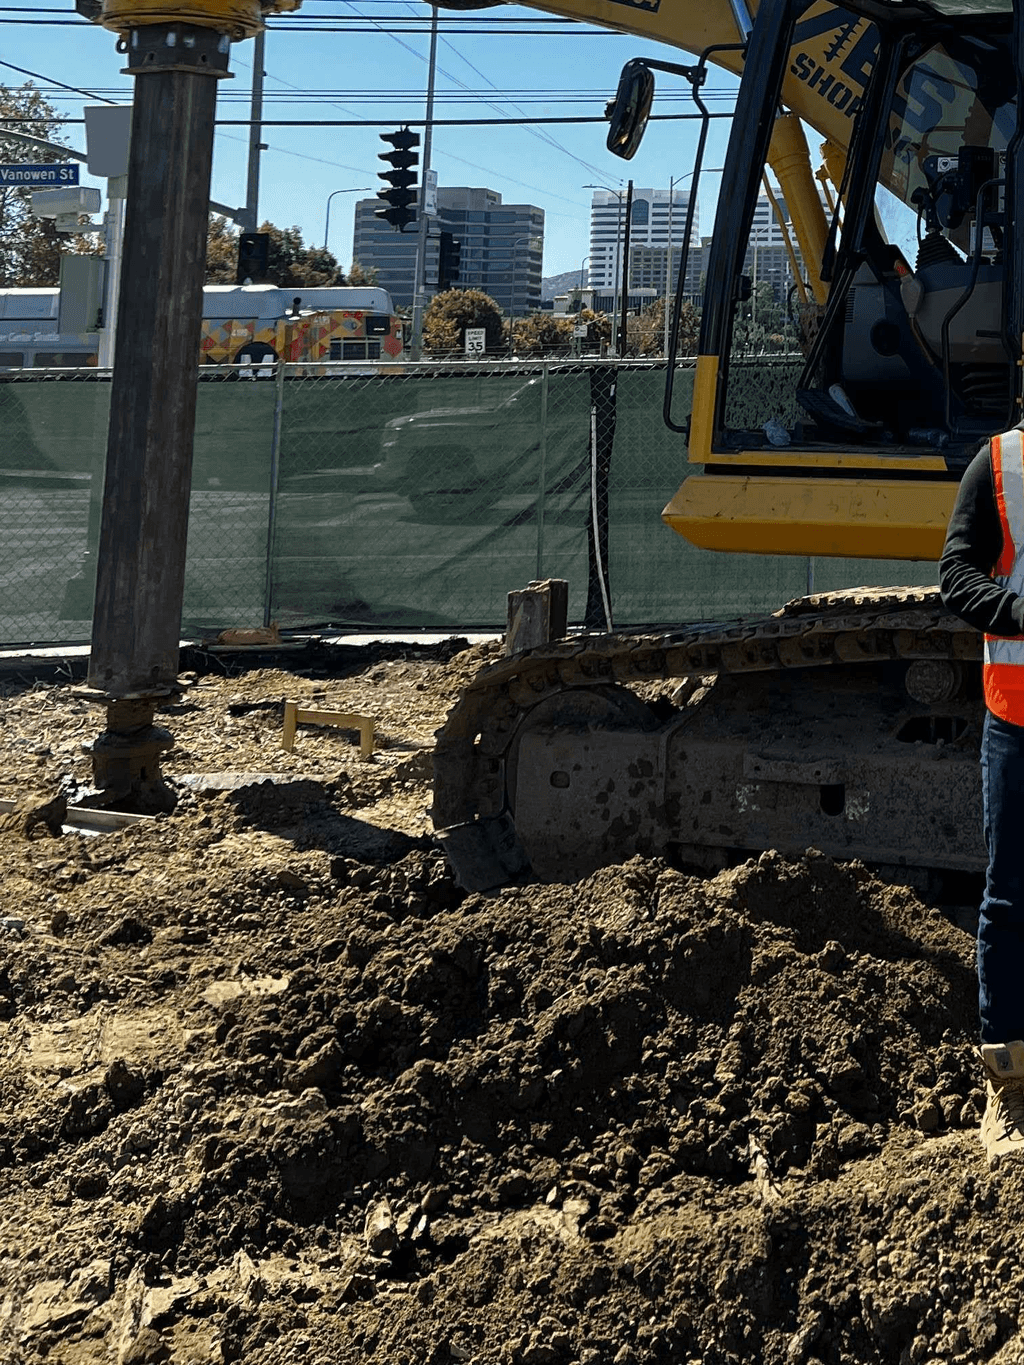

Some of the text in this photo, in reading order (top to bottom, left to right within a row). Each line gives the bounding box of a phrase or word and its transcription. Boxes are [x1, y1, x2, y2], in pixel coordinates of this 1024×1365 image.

[0, 168, 75, 181] Vanowen St
[468, 342, 483, 351] 35
